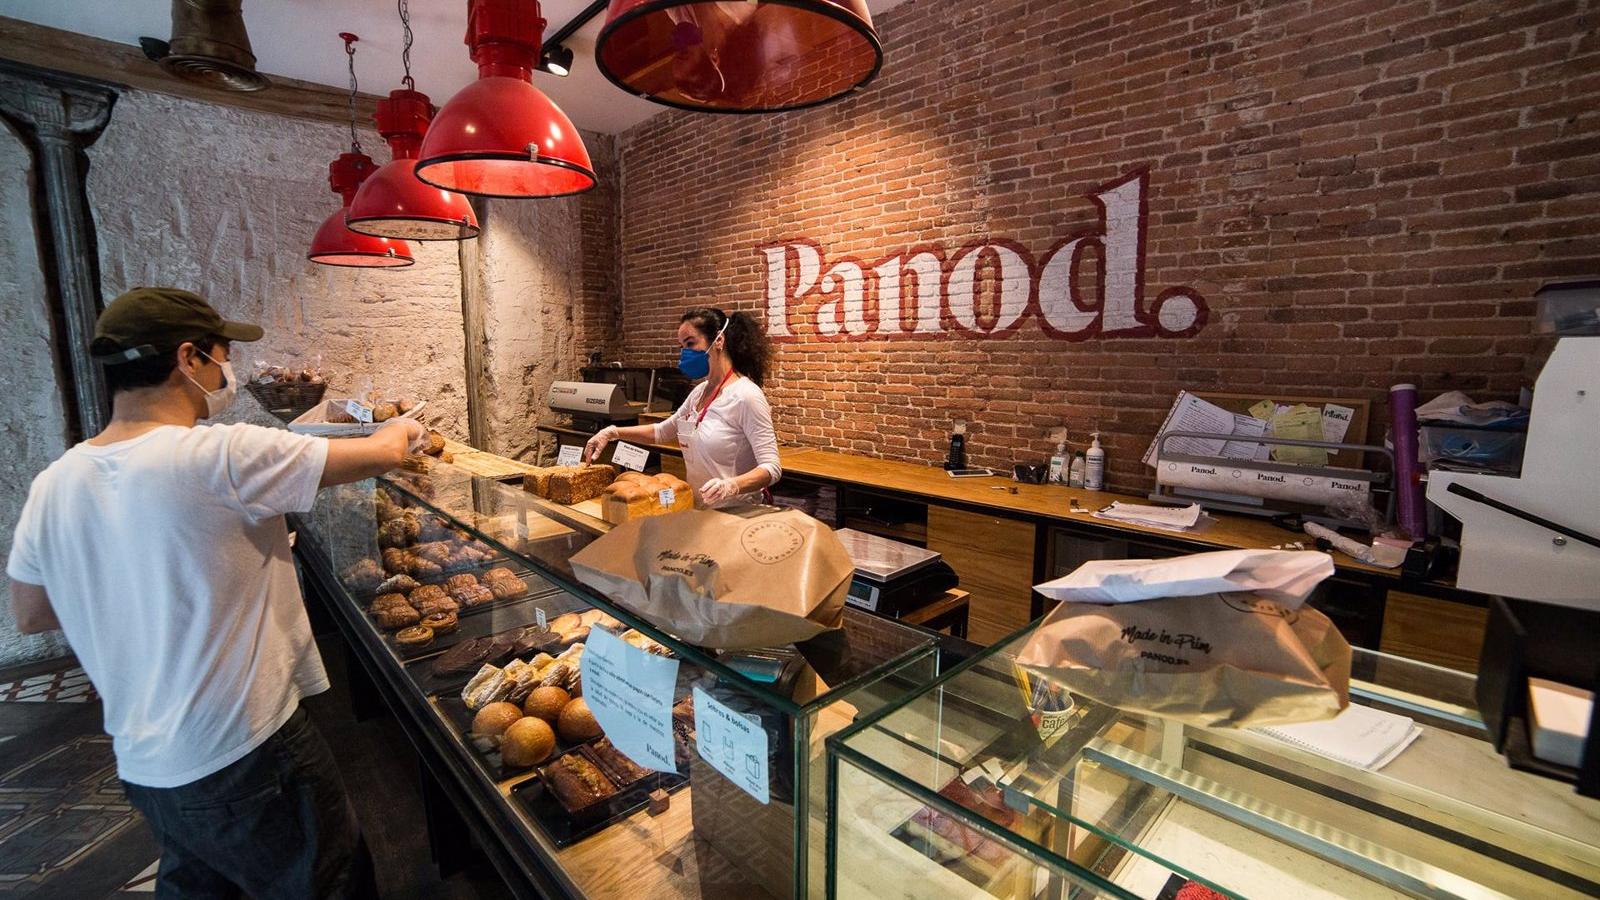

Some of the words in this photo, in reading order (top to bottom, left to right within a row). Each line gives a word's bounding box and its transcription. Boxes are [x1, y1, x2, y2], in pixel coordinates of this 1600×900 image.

[756, 165, 1209, 341] Panod.
[1191, 466, 1217, 476] Panod.
[1257, 473, 1286, 483] Panod.
[1331, 481, 1364, 492] Panod.
[1120, 625, 1158, 644] Made
[1159, 629, 1173, 645] in
[707, 701, 725, 718] Sobres
[726, 714, 731, 722] &
[732, 717, 750, 734] bolsas
